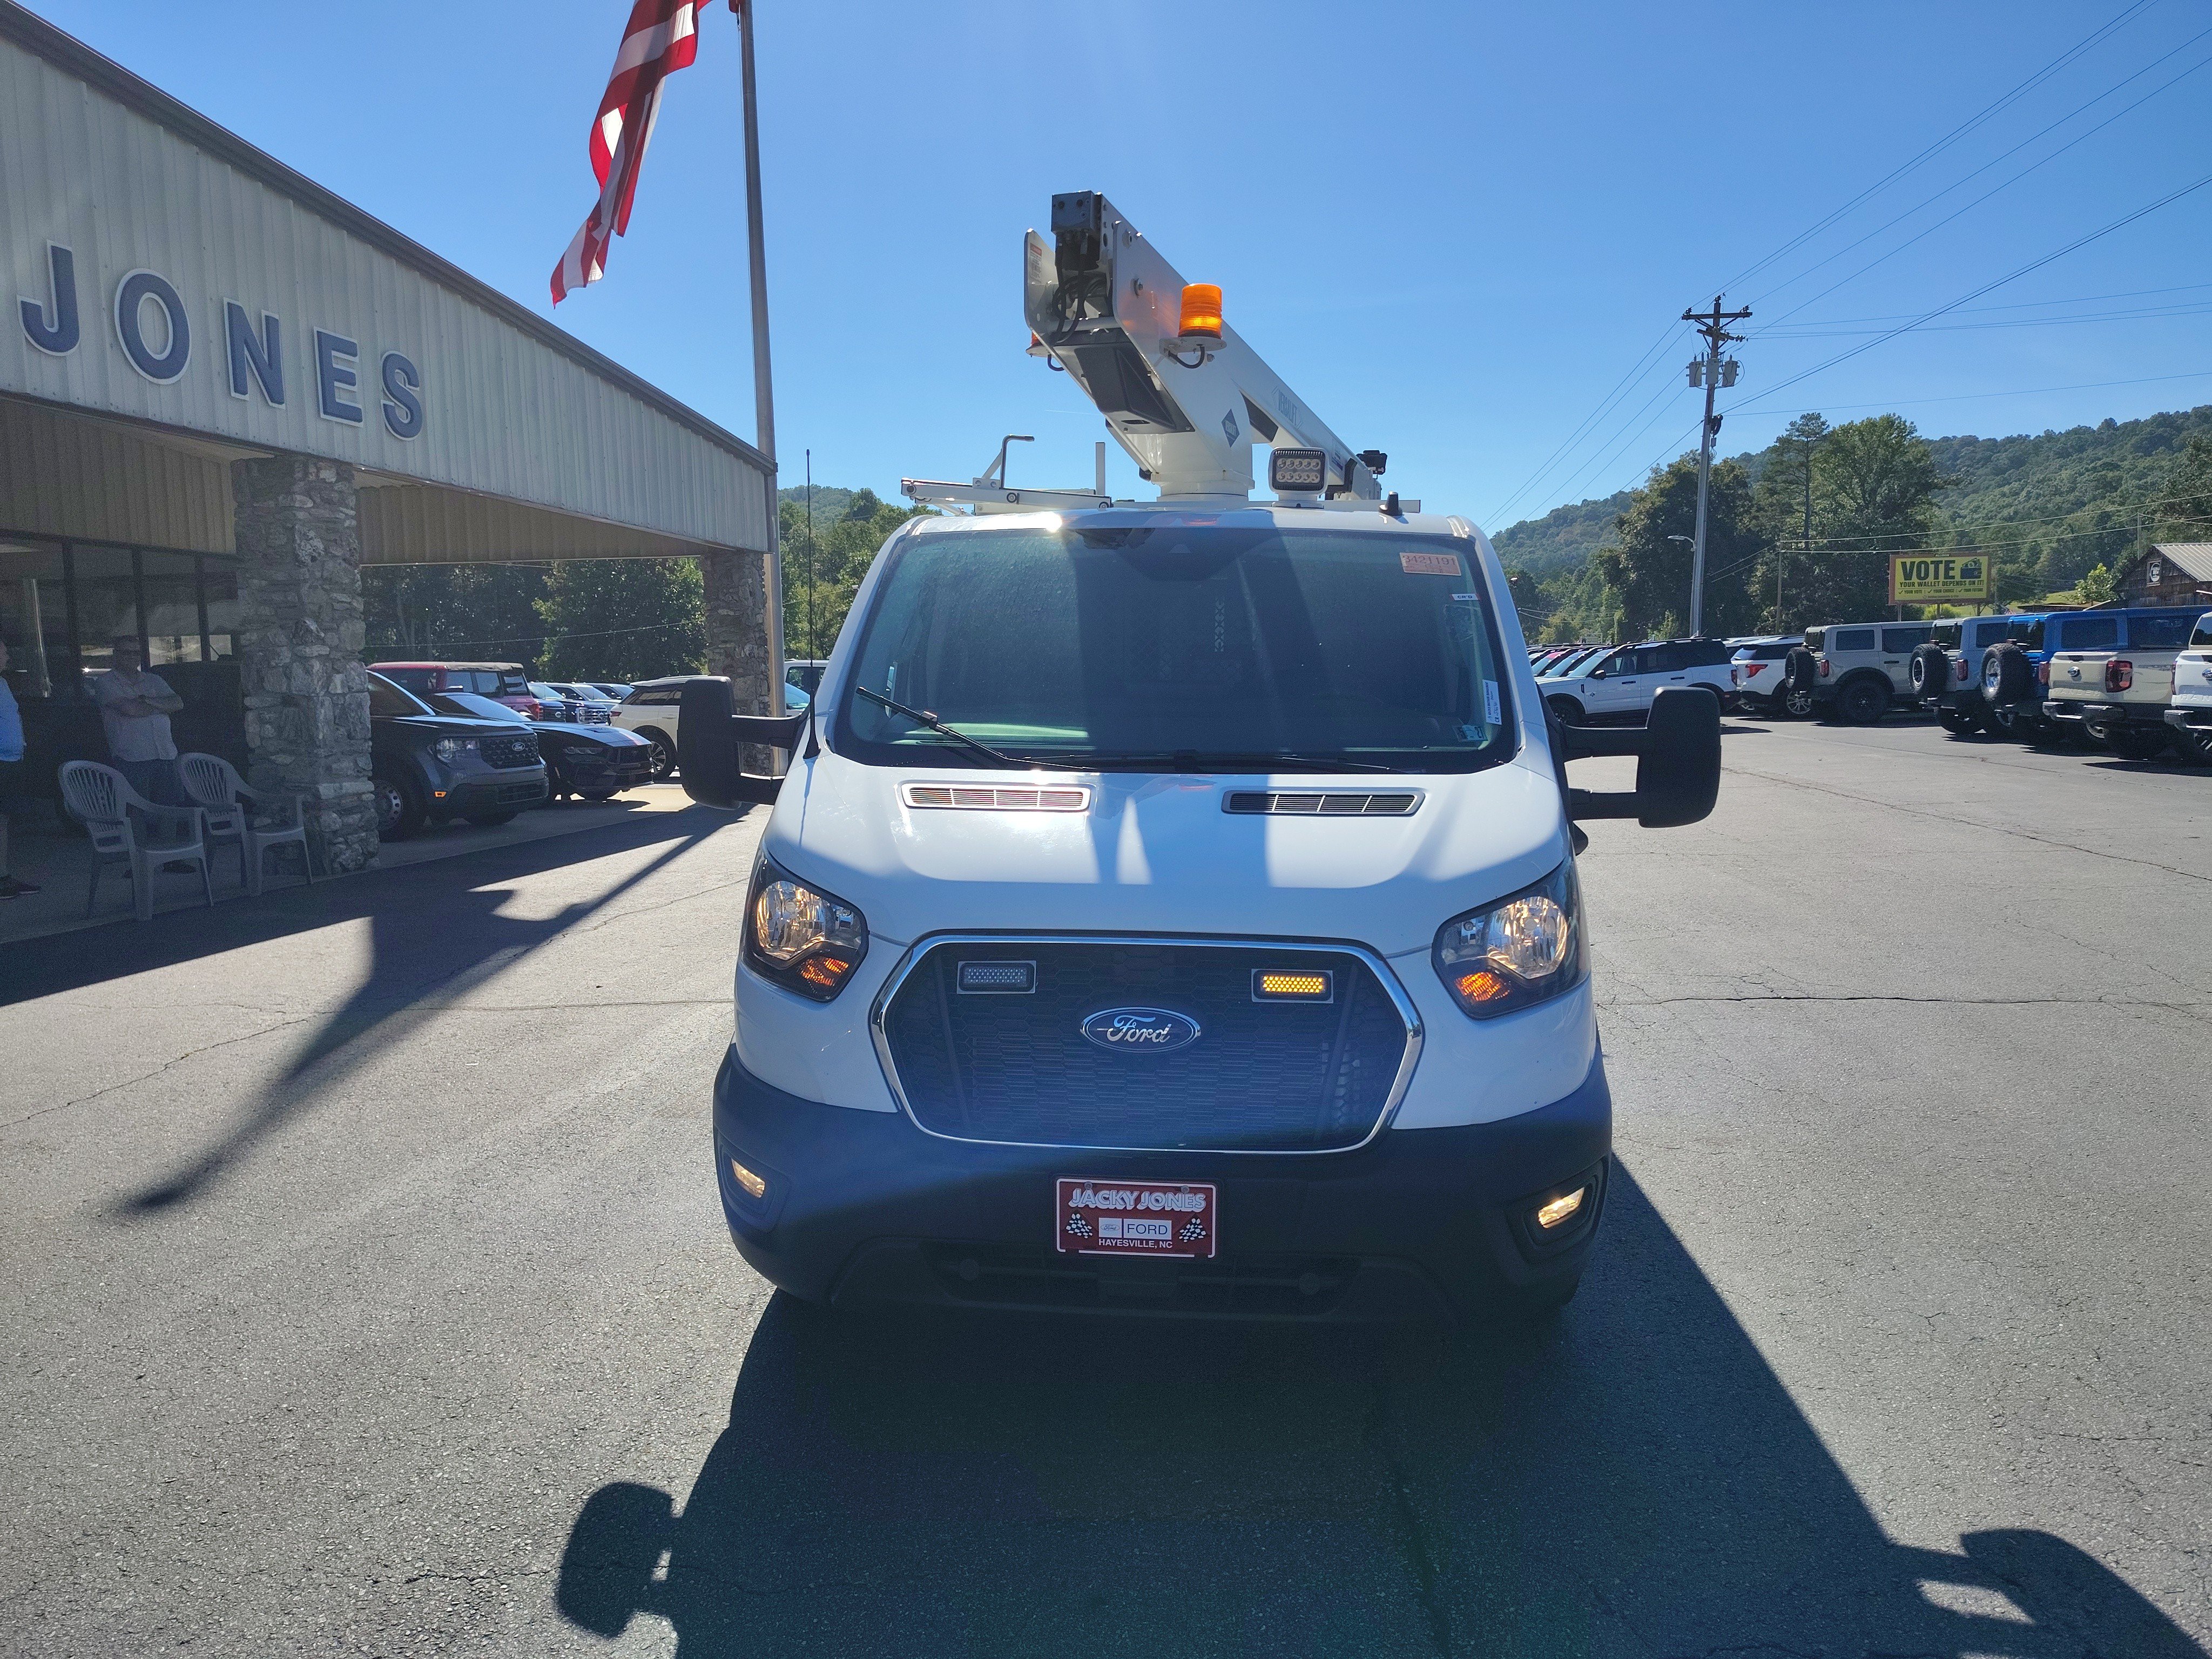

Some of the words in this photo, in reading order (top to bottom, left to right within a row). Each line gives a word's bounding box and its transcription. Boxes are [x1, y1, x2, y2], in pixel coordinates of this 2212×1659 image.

[17, 239, 423, 441] JONES
[1278, 389, 1297, 426] VERSALIFT
[1900, 559, 1955, 581] VOTE
[1097, 1015, 1172, 1043] Ford
[1068, 1188, 1139, 1210] JACKY
[1137, 1191, 1206, 1212] JONES
[1127, 1223, 1168, 1235] FORD
[1098, 1238, 1157, 1249] HAYESVILLE,
[1159, 1240, 1172, 1249] NC
